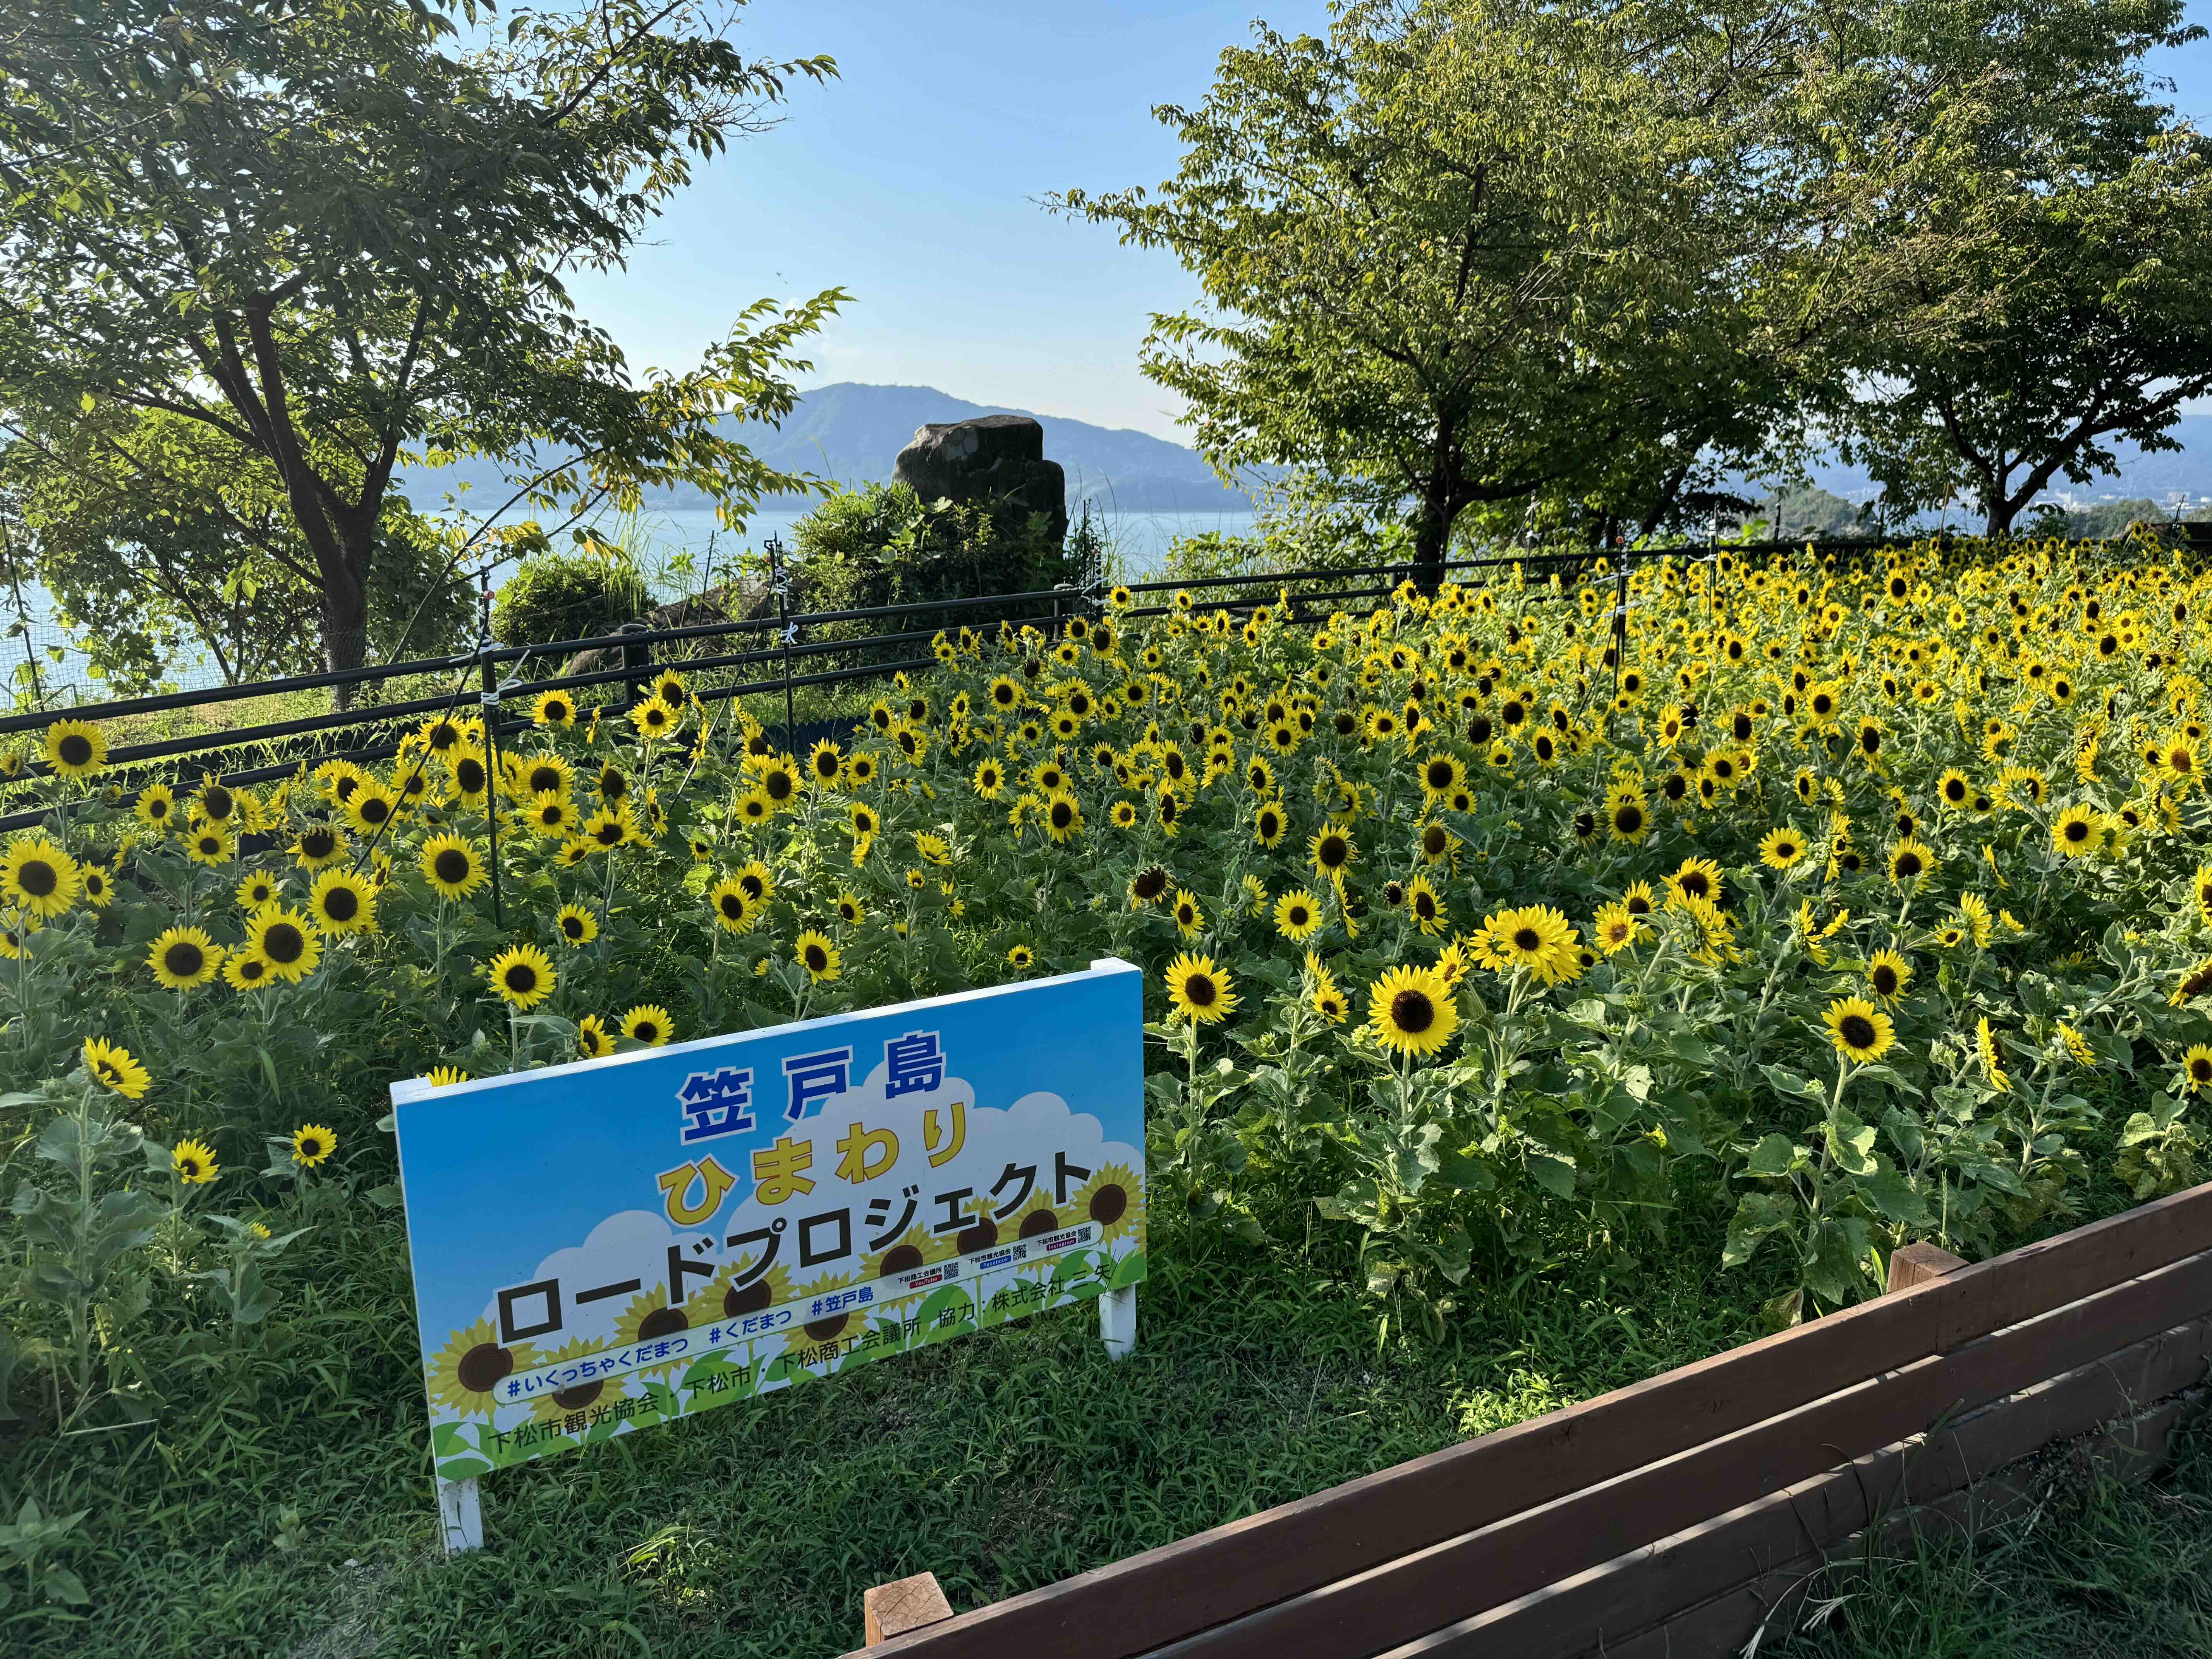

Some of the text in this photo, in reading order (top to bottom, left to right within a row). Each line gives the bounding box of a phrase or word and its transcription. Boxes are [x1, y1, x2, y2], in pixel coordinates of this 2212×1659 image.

[682, 1034, 943, 1141] 笠戸島
[659, 1102, 965, 1224] ひまわり
[497, 1151, 1091, 1344] ロードプロジェクト
[915, 1278, 938, 1286] YouTube
[983, 1257, 1009, 1267] Facebook
[1049, 1240, 1075, 1250] Instagram
[507, 1286, 873, 1396] #いくっちゃくだまつ #くだまつ #笠戸島
